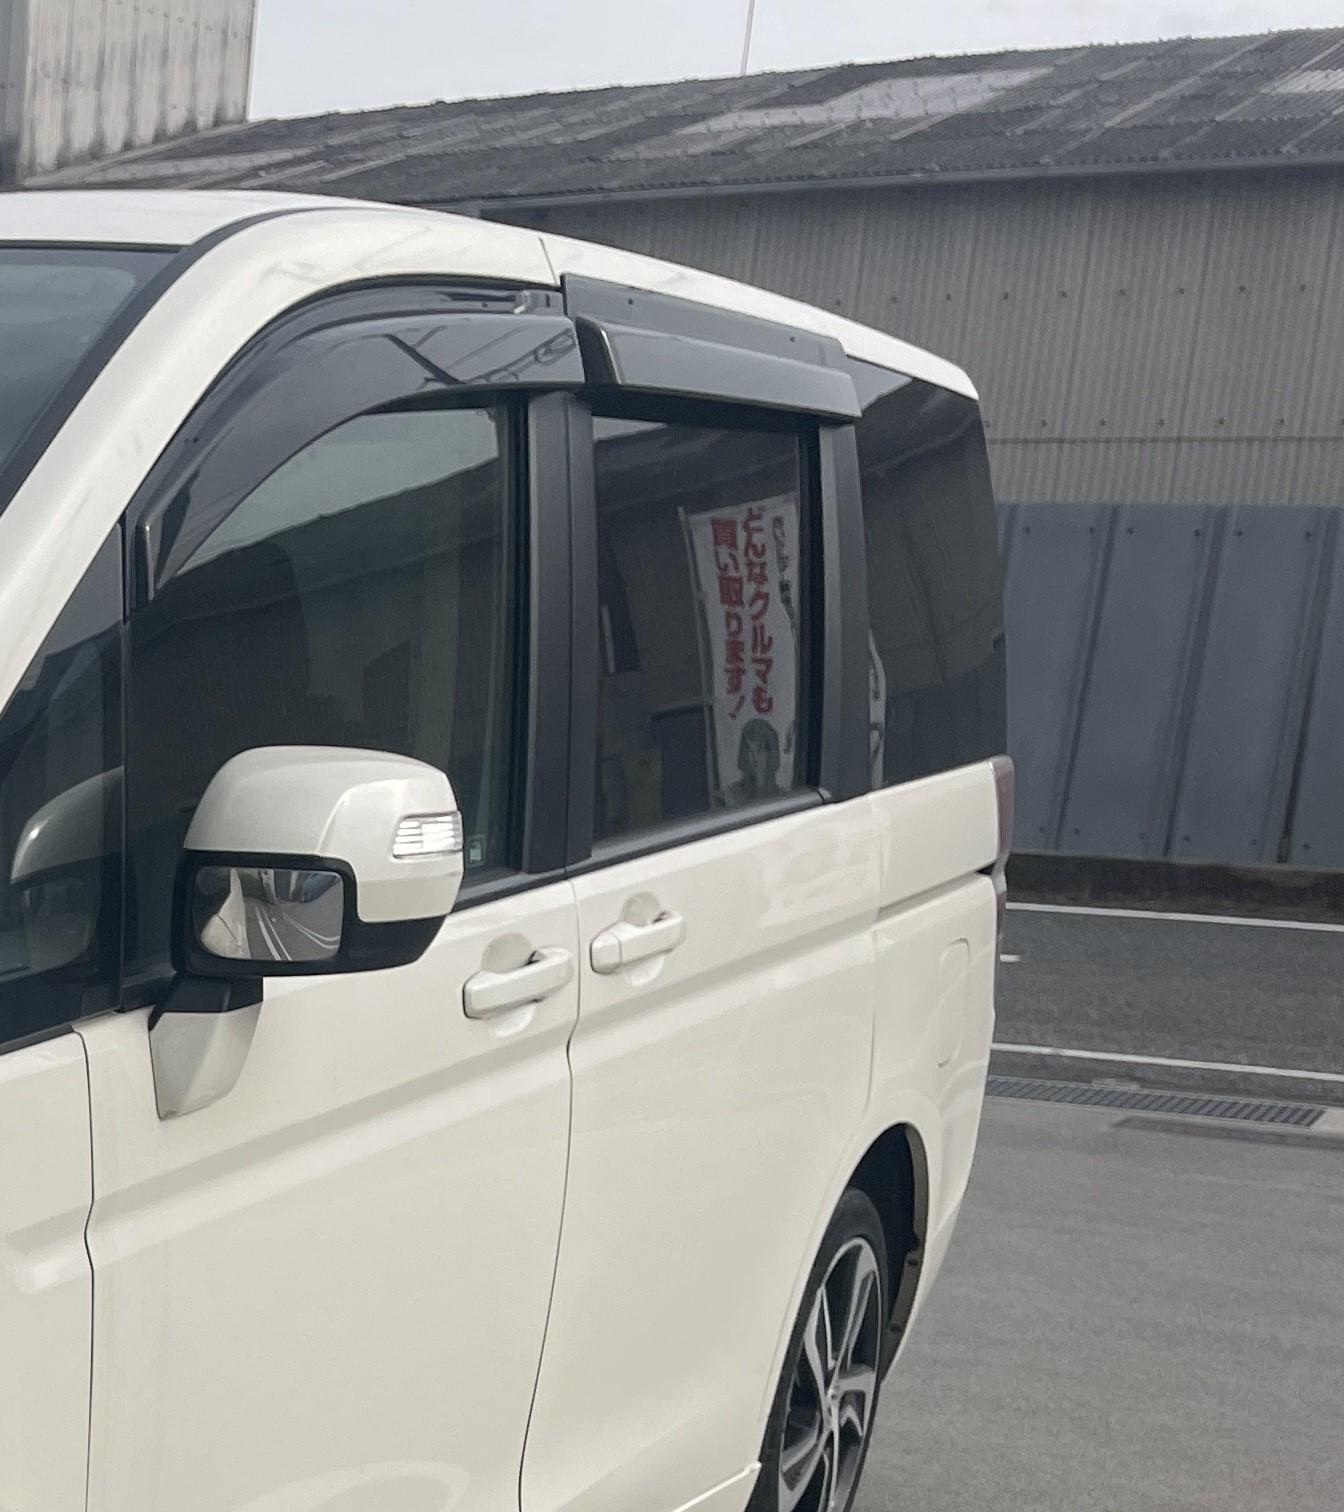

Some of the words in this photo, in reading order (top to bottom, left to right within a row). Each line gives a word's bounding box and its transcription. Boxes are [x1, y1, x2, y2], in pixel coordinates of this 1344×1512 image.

[742, 506, 774, 714] どんなクルマも
